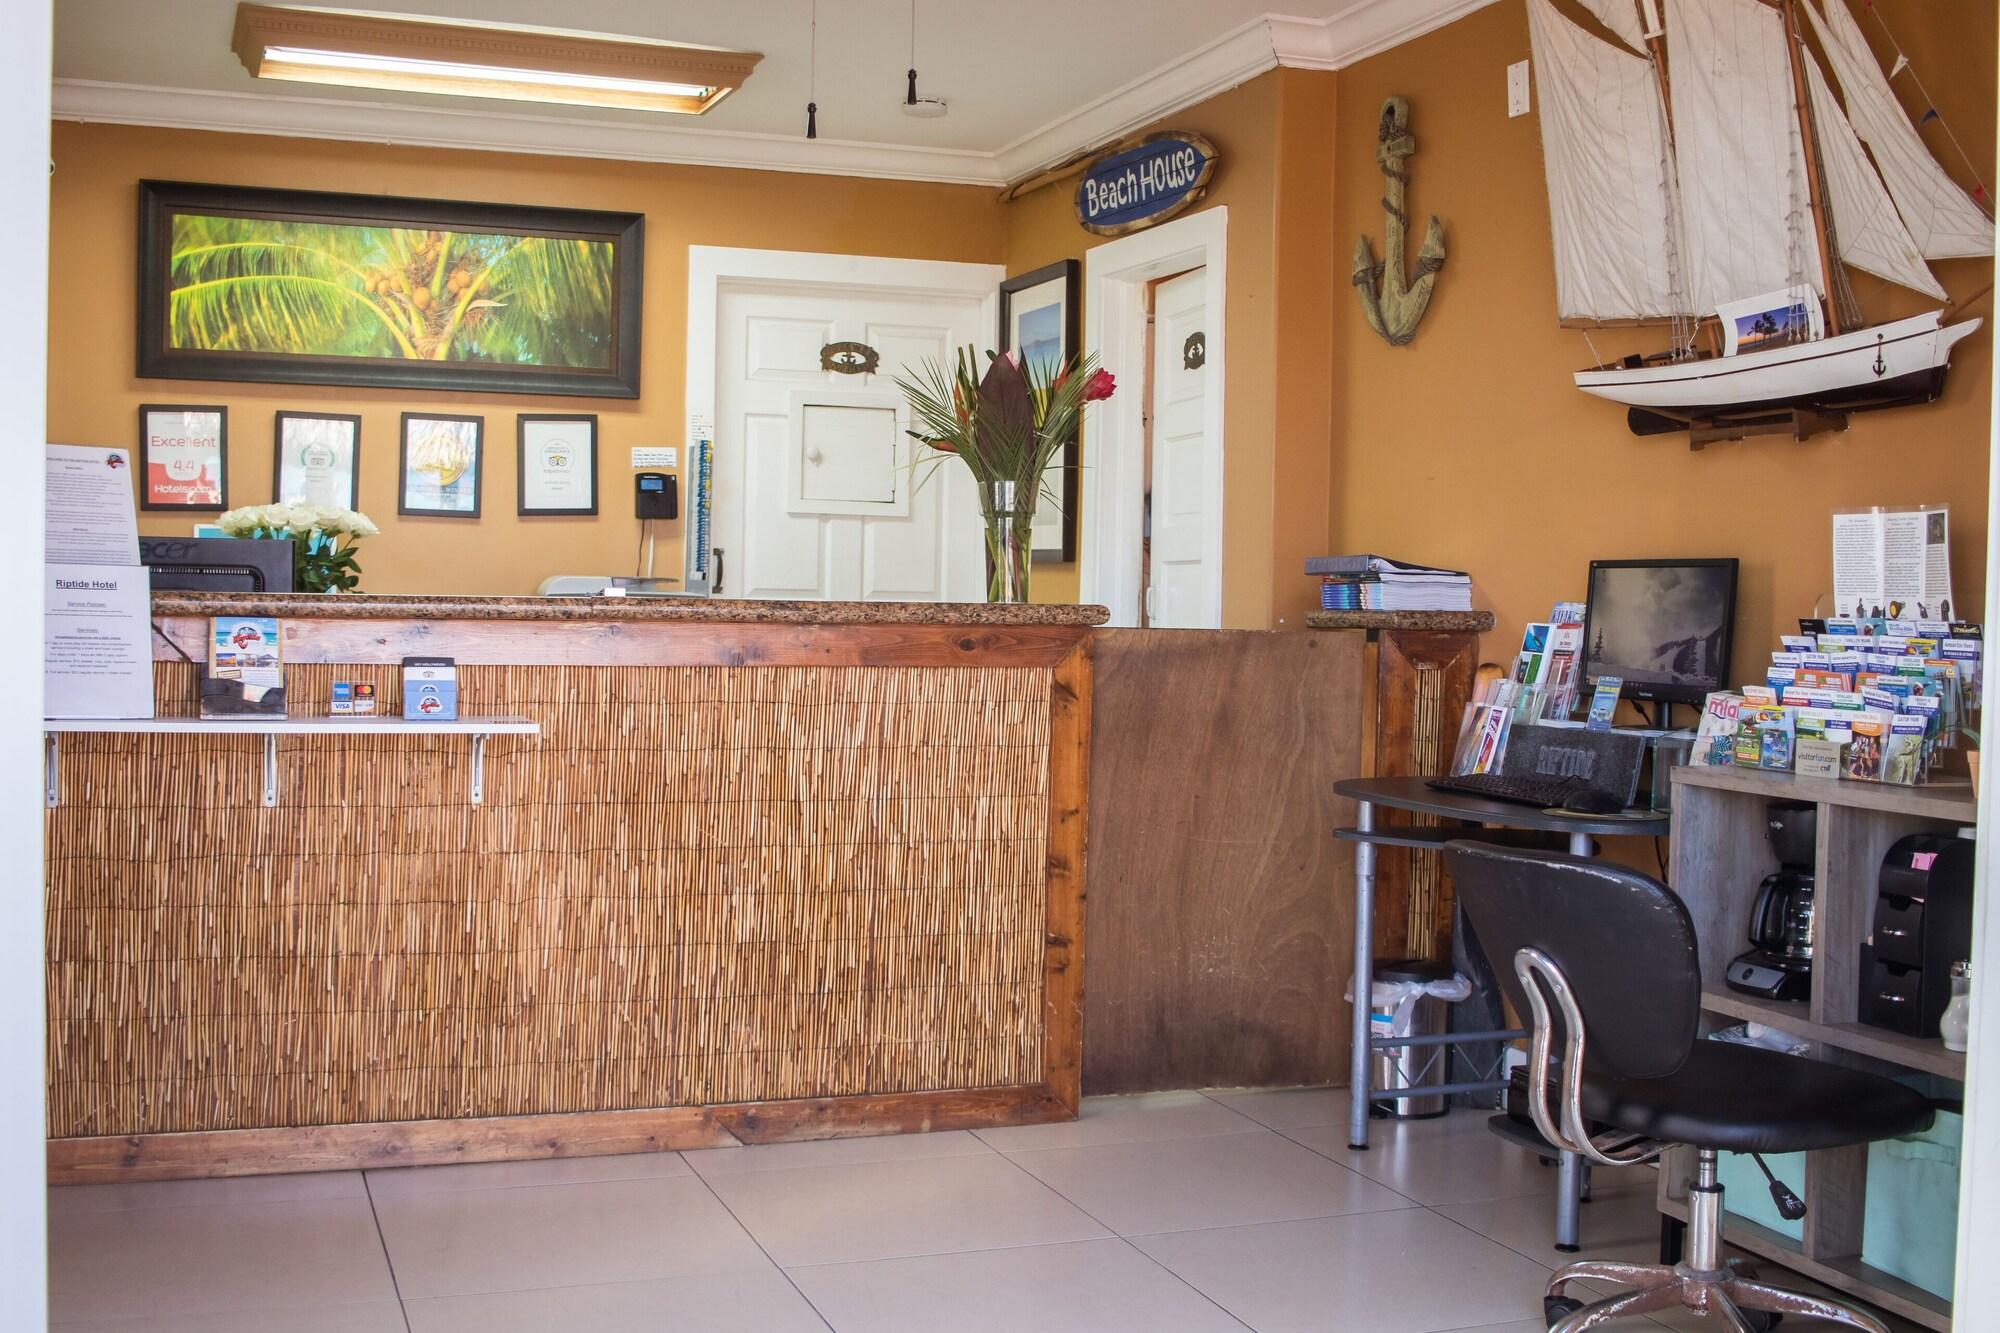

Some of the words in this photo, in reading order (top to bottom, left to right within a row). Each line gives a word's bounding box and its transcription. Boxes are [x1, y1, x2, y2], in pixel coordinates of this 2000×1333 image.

[1086, 168, 1138, 217] Beach
[152, 435, 216, 448] Excellent
[173, 459, 194, 472] 4.4
[56, 579, 89, 590] Riptide
[92, 580, 117, 590] Hotel
